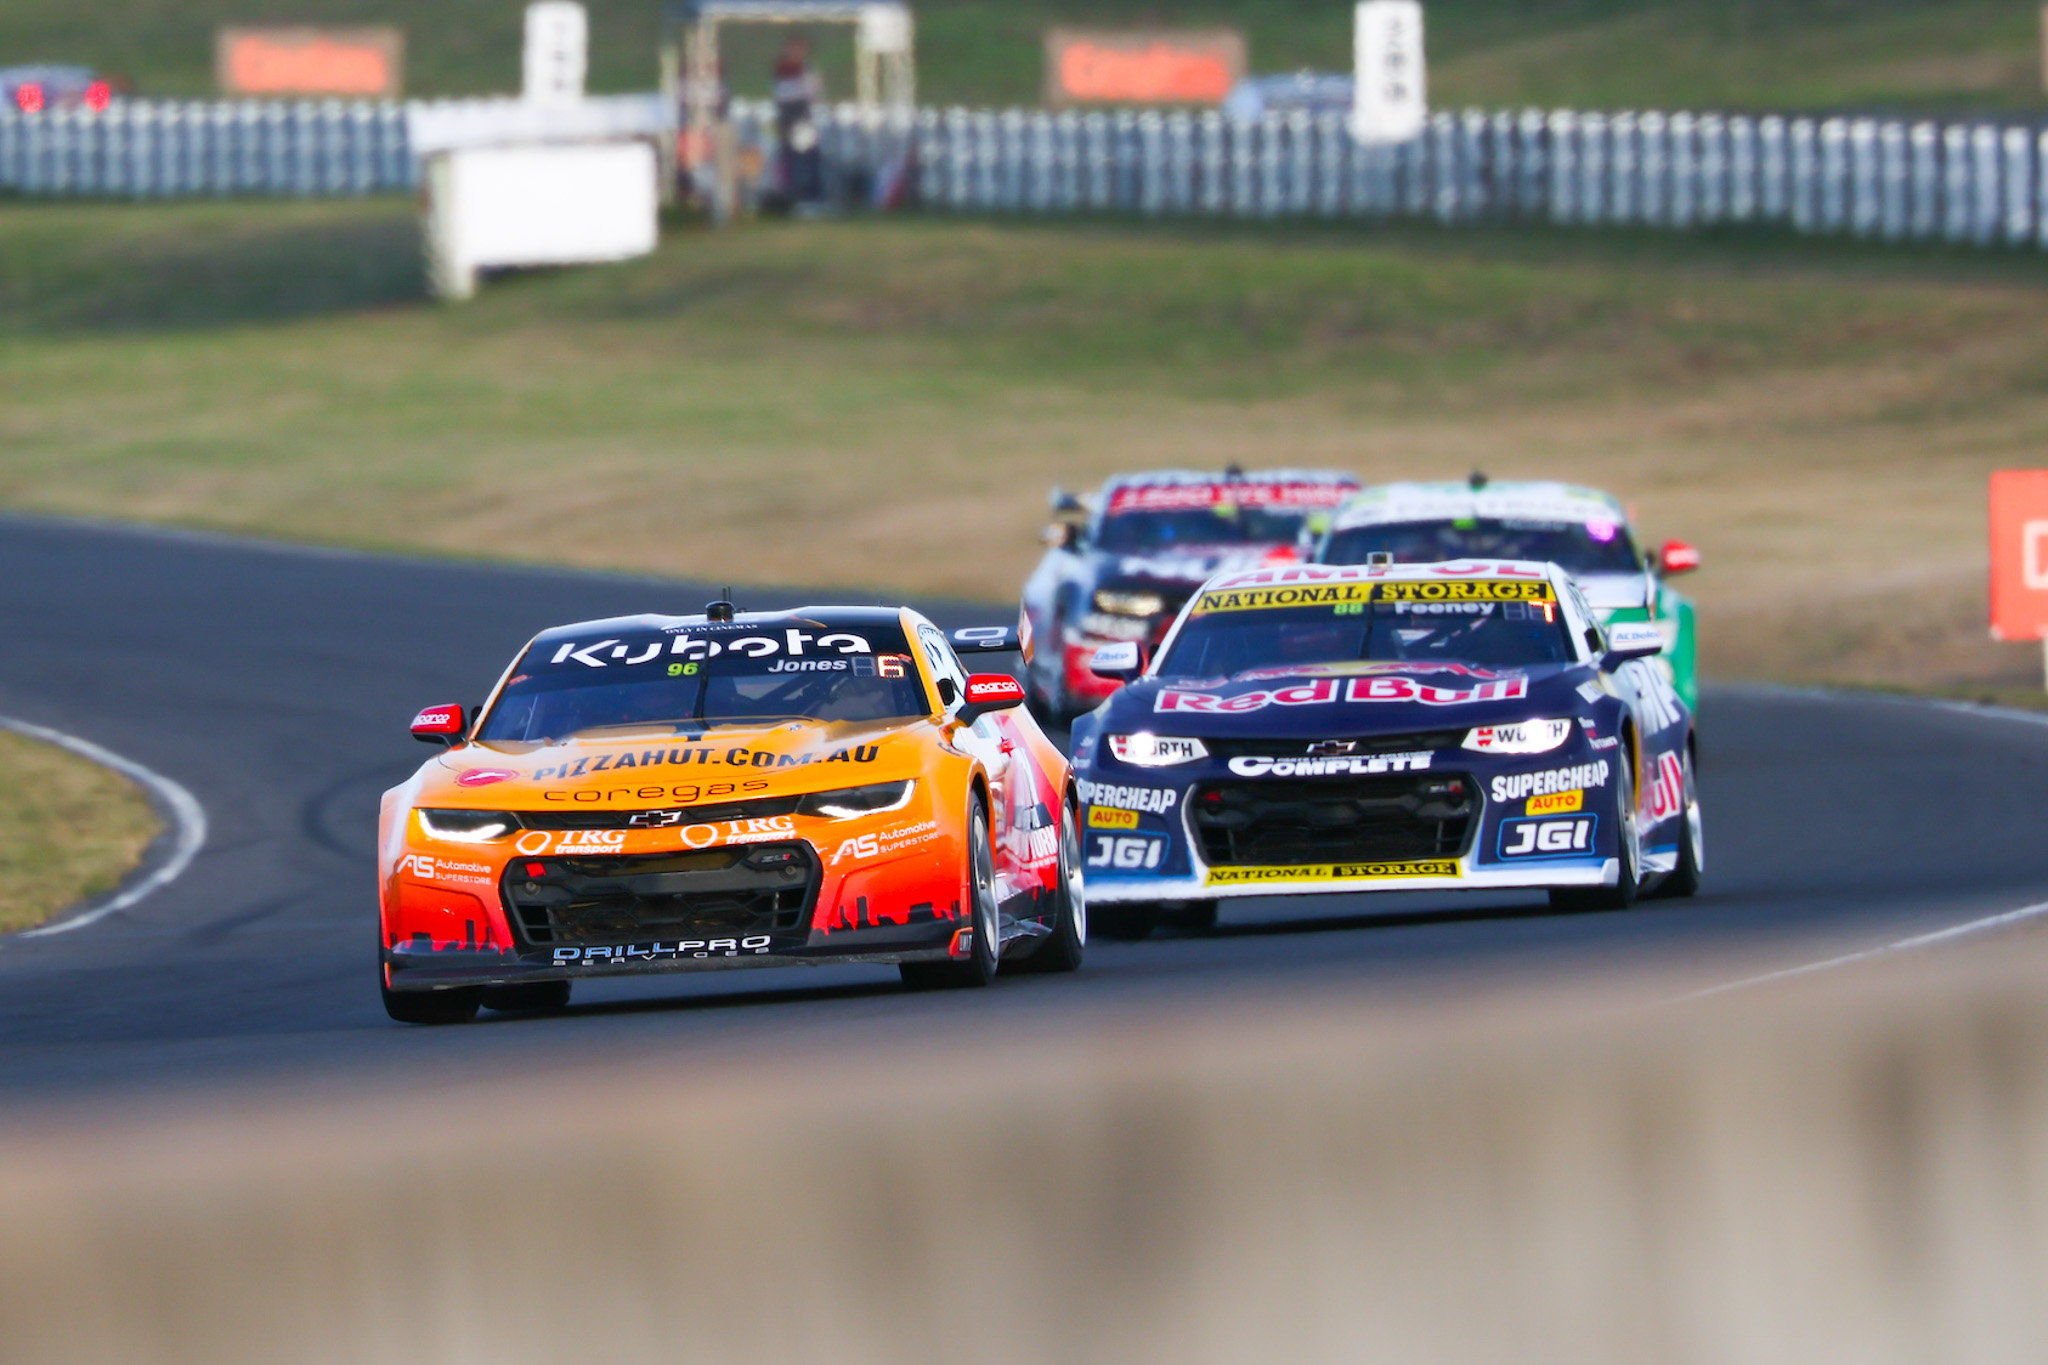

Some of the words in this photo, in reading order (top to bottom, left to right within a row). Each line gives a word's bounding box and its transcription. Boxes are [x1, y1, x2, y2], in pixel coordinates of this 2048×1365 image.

[1203, 587, 1363, 610] NATIONAL
[1382, 583, 1540, 600] STORAGE
[1334, 602, 1364, 616] 88
[1395, 600, 1495, 616] Feeney
[551, 628, 872, 668] Kubota
[667, 662, 699, 677] 96
[768, 659, 848, 673] Jones
[969, 682, 1019, 694] sparco
[1154, 679, 1340, 714] Red
[1345, 676, 1529, 706] Bull
[532, 745, 880, 781] PIZZAHUT.COM.AU
[544, 779, 769, 803] coregas
[1491, 760, 1609, 803] SUPERCHEAP
[1532, 795, 1577, 810] AUTO
[721, 816, 795, 835] TRG
[1093, 811, 1133, 824] AUTO
[559, 830, 628, 845] TRG
[725, 830, 798, 845] transport
[878, 819, 937, 842] Automotive
[1504, 820, 1590, 854] JGI
[554, 843, 624, 855] transport
[879, 831, 940, 854] SUPERSTORE
[1087, 836, 1162, 869] JGI
[435, 858, 492, 874] Automotive
[1208, 867, 1329, 882] NATIONAL
[1339, 861, 1454, 878] STORAGE
[434, 872, 491, 886] SUPERSTORE
[553, 934, 772, 960] DRILLPRO
